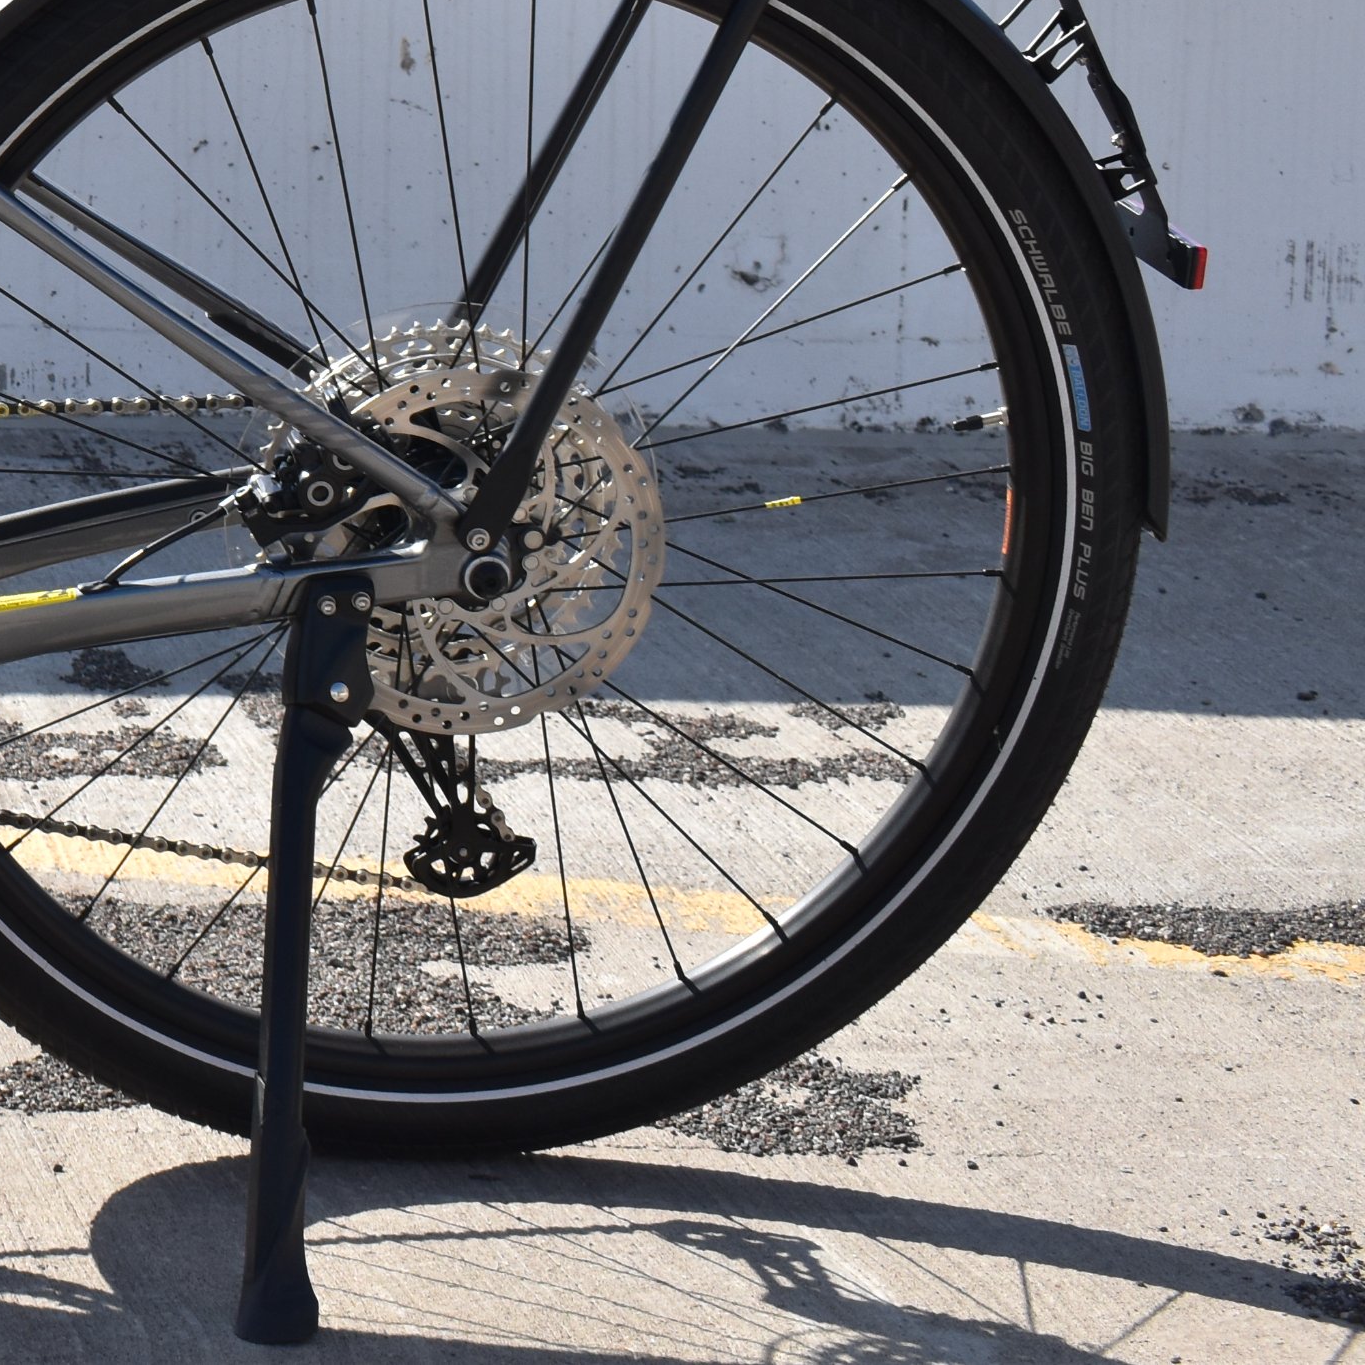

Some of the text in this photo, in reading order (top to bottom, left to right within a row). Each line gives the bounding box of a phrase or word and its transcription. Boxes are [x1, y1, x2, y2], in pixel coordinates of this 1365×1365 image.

[1009, 208, 1073, 336] SCHWALBE
[1073, 440, 1095, 601] BIG BEN PLUS
